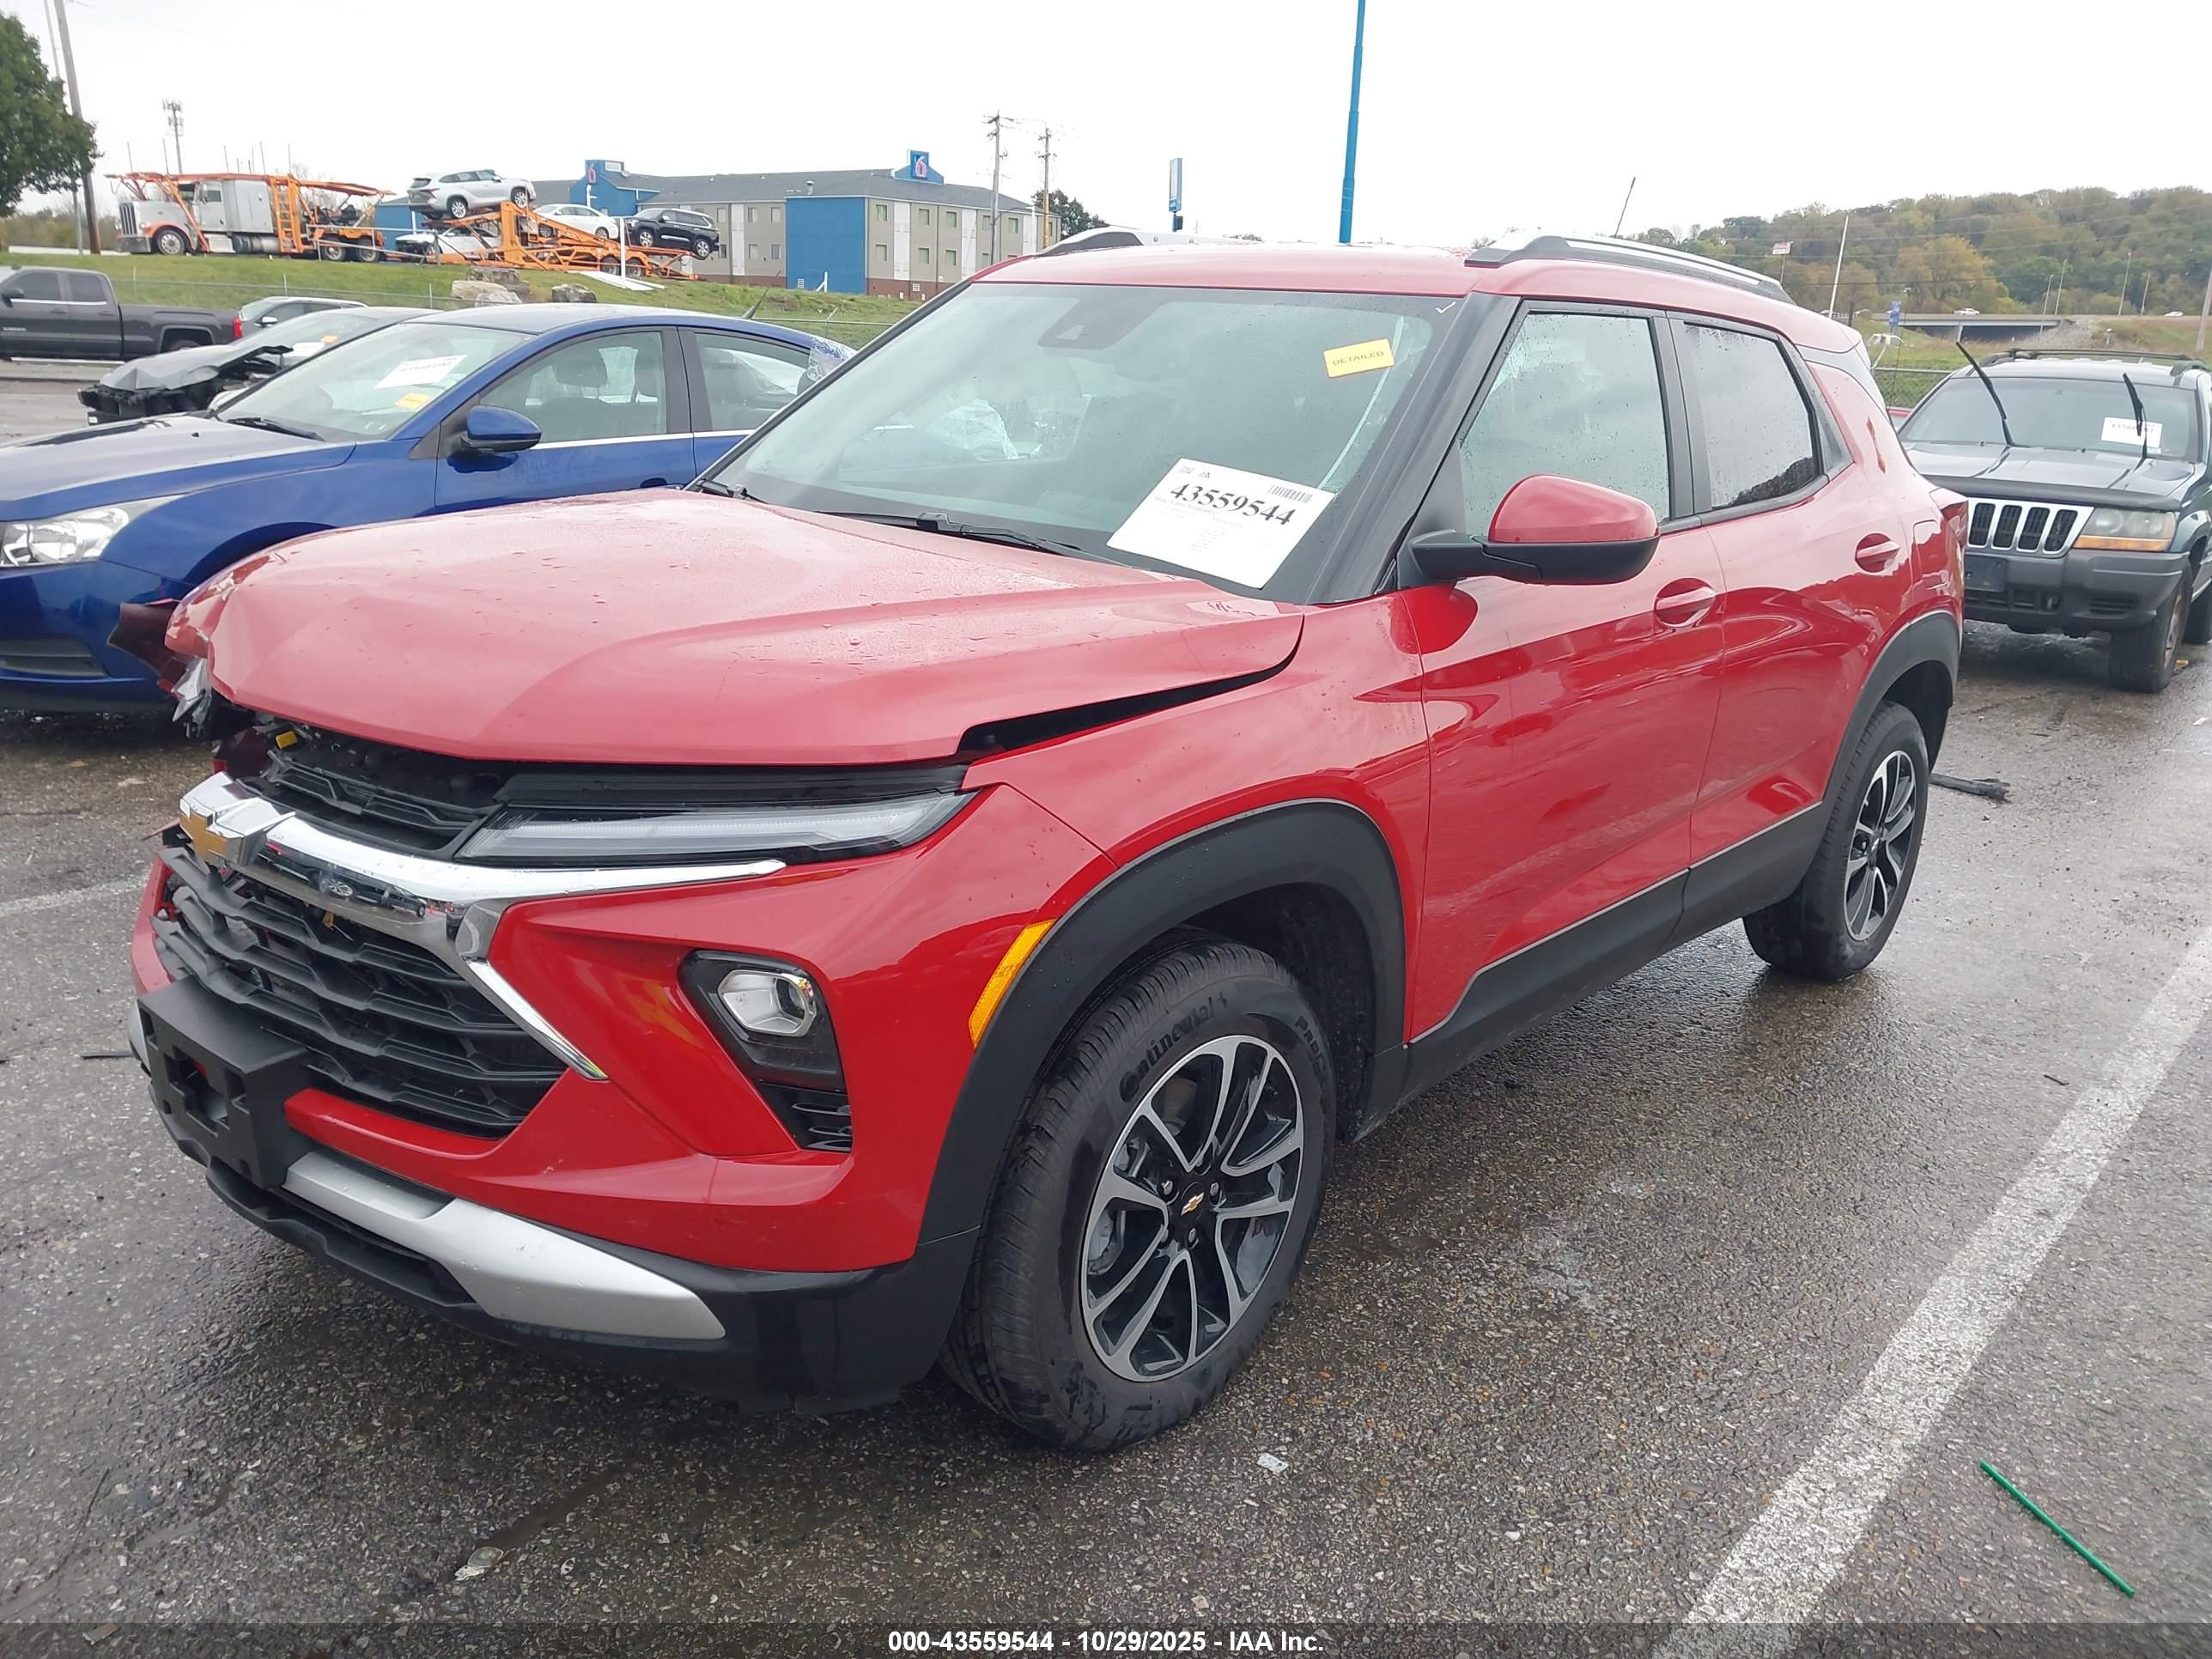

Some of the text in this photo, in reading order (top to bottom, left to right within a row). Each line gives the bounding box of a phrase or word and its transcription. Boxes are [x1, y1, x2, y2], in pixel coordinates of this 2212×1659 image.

[915, 155, 927, 178] 6
[1332, 350, 1384, 366] DETAILED
[1170, 483, 1297, 526] 43559544
